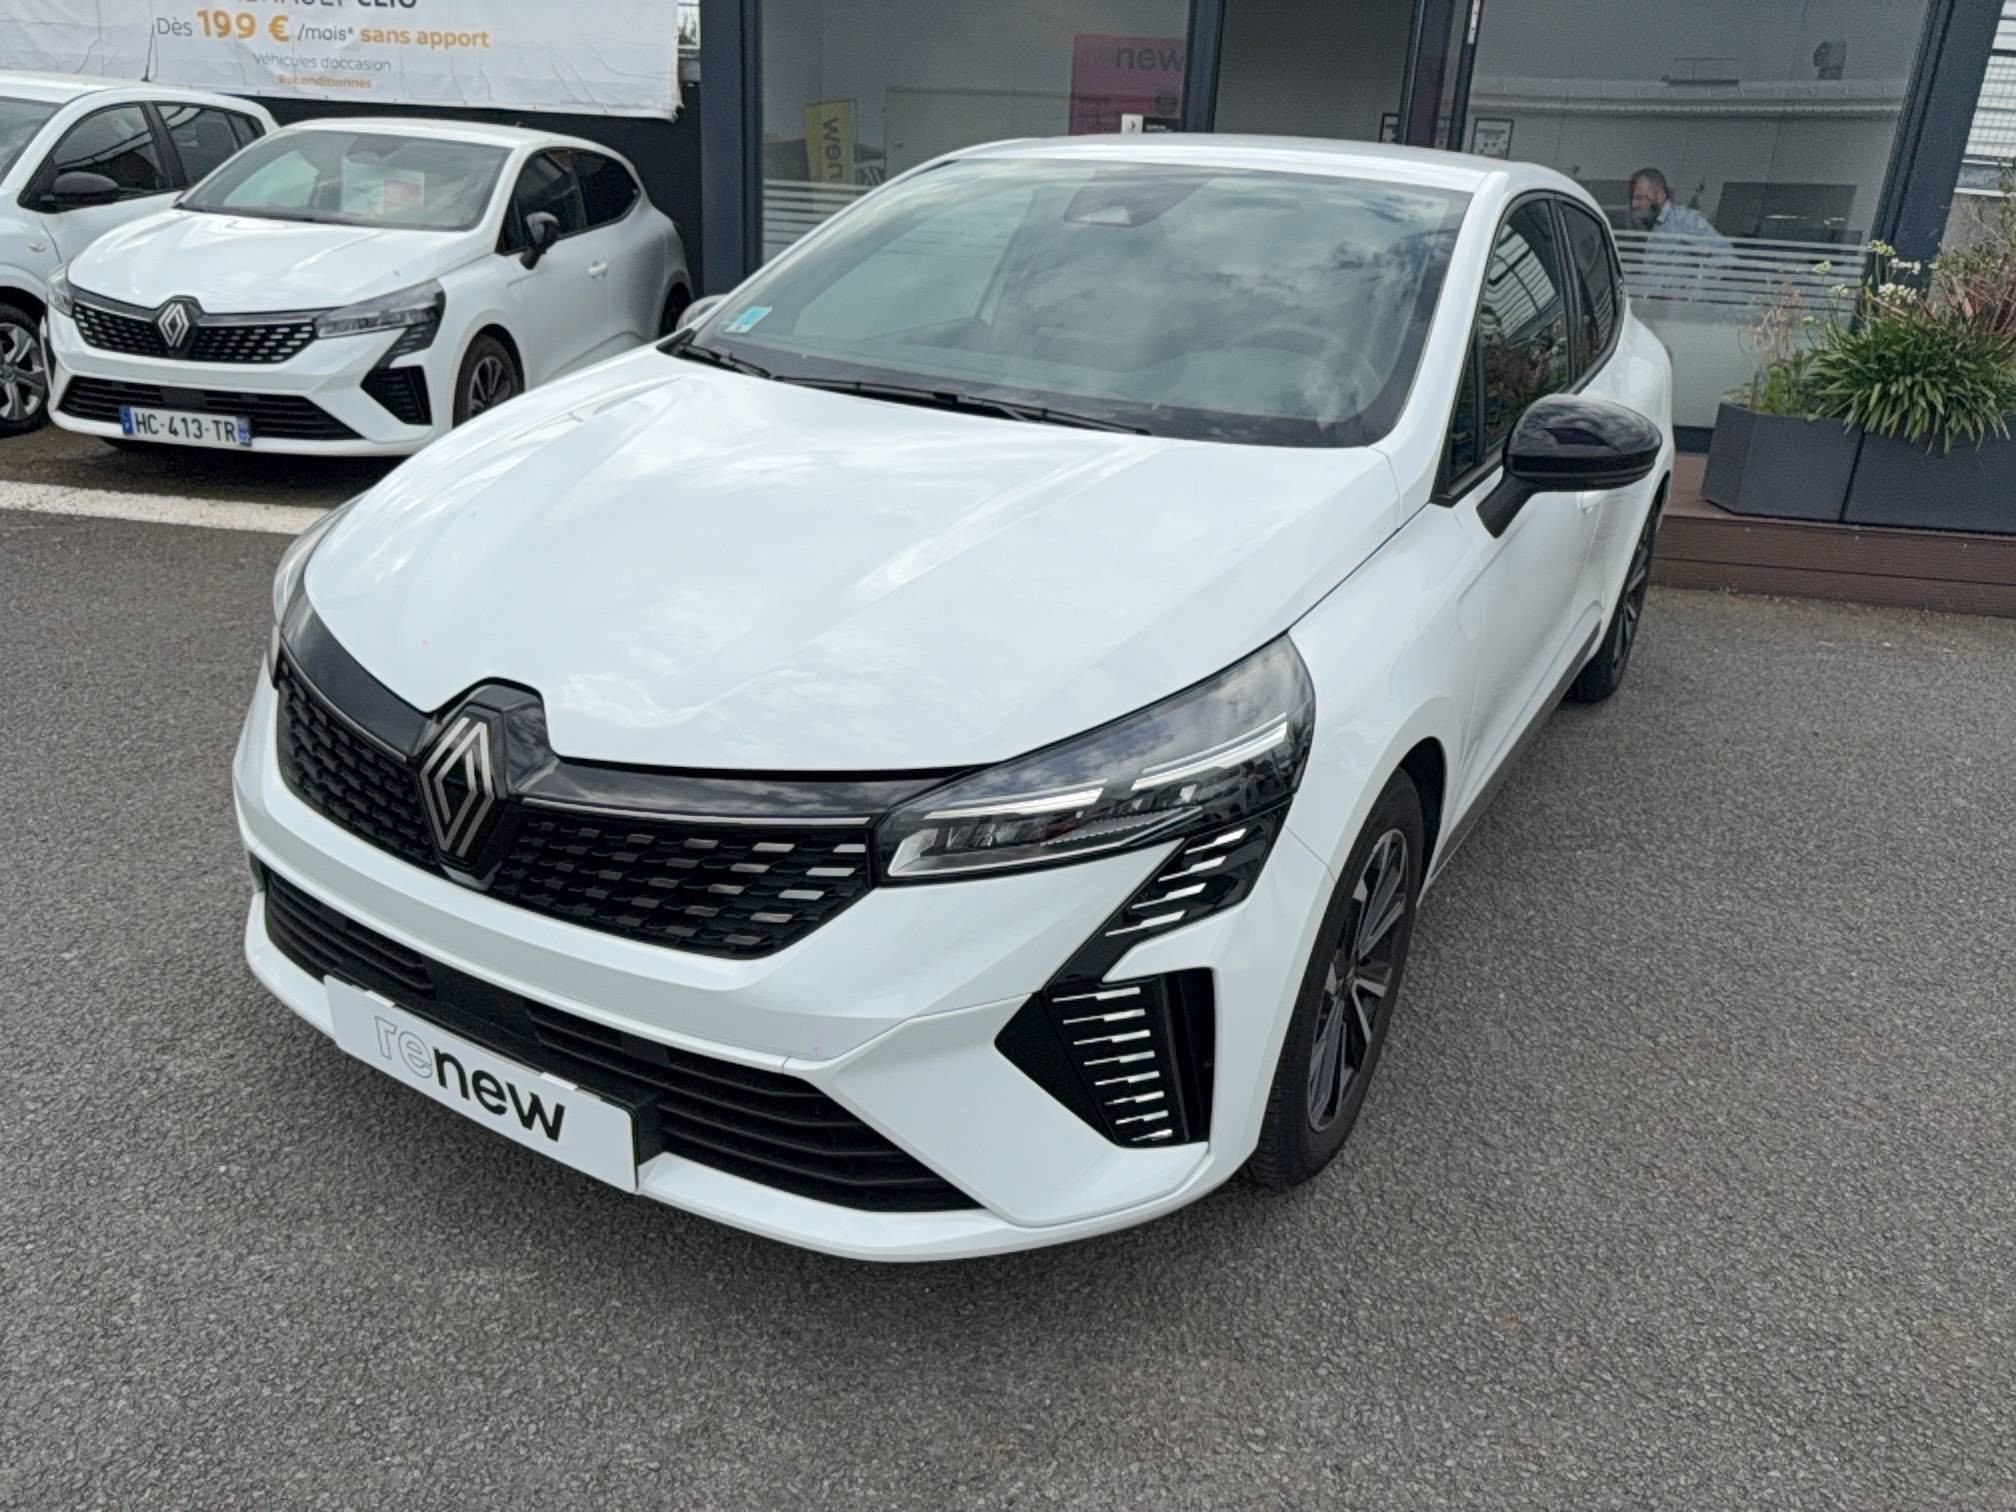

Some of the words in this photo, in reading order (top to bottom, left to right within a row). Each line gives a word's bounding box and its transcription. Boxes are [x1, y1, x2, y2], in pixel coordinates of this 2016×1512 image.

[156, 17, 193, 36] Dès
[196, 9, 257, 39] 199
[268, 15, 289, 42] €
[360, 28, 411, 45] sans
[416, 30, 491, 50] apport
[252, 51, 318, 69] Véhicules
[321, 57, 392, 72] d'occasion
[134, 412, 237, 442] HC-413-TR
[374, 1016, 566, 1142] renew
